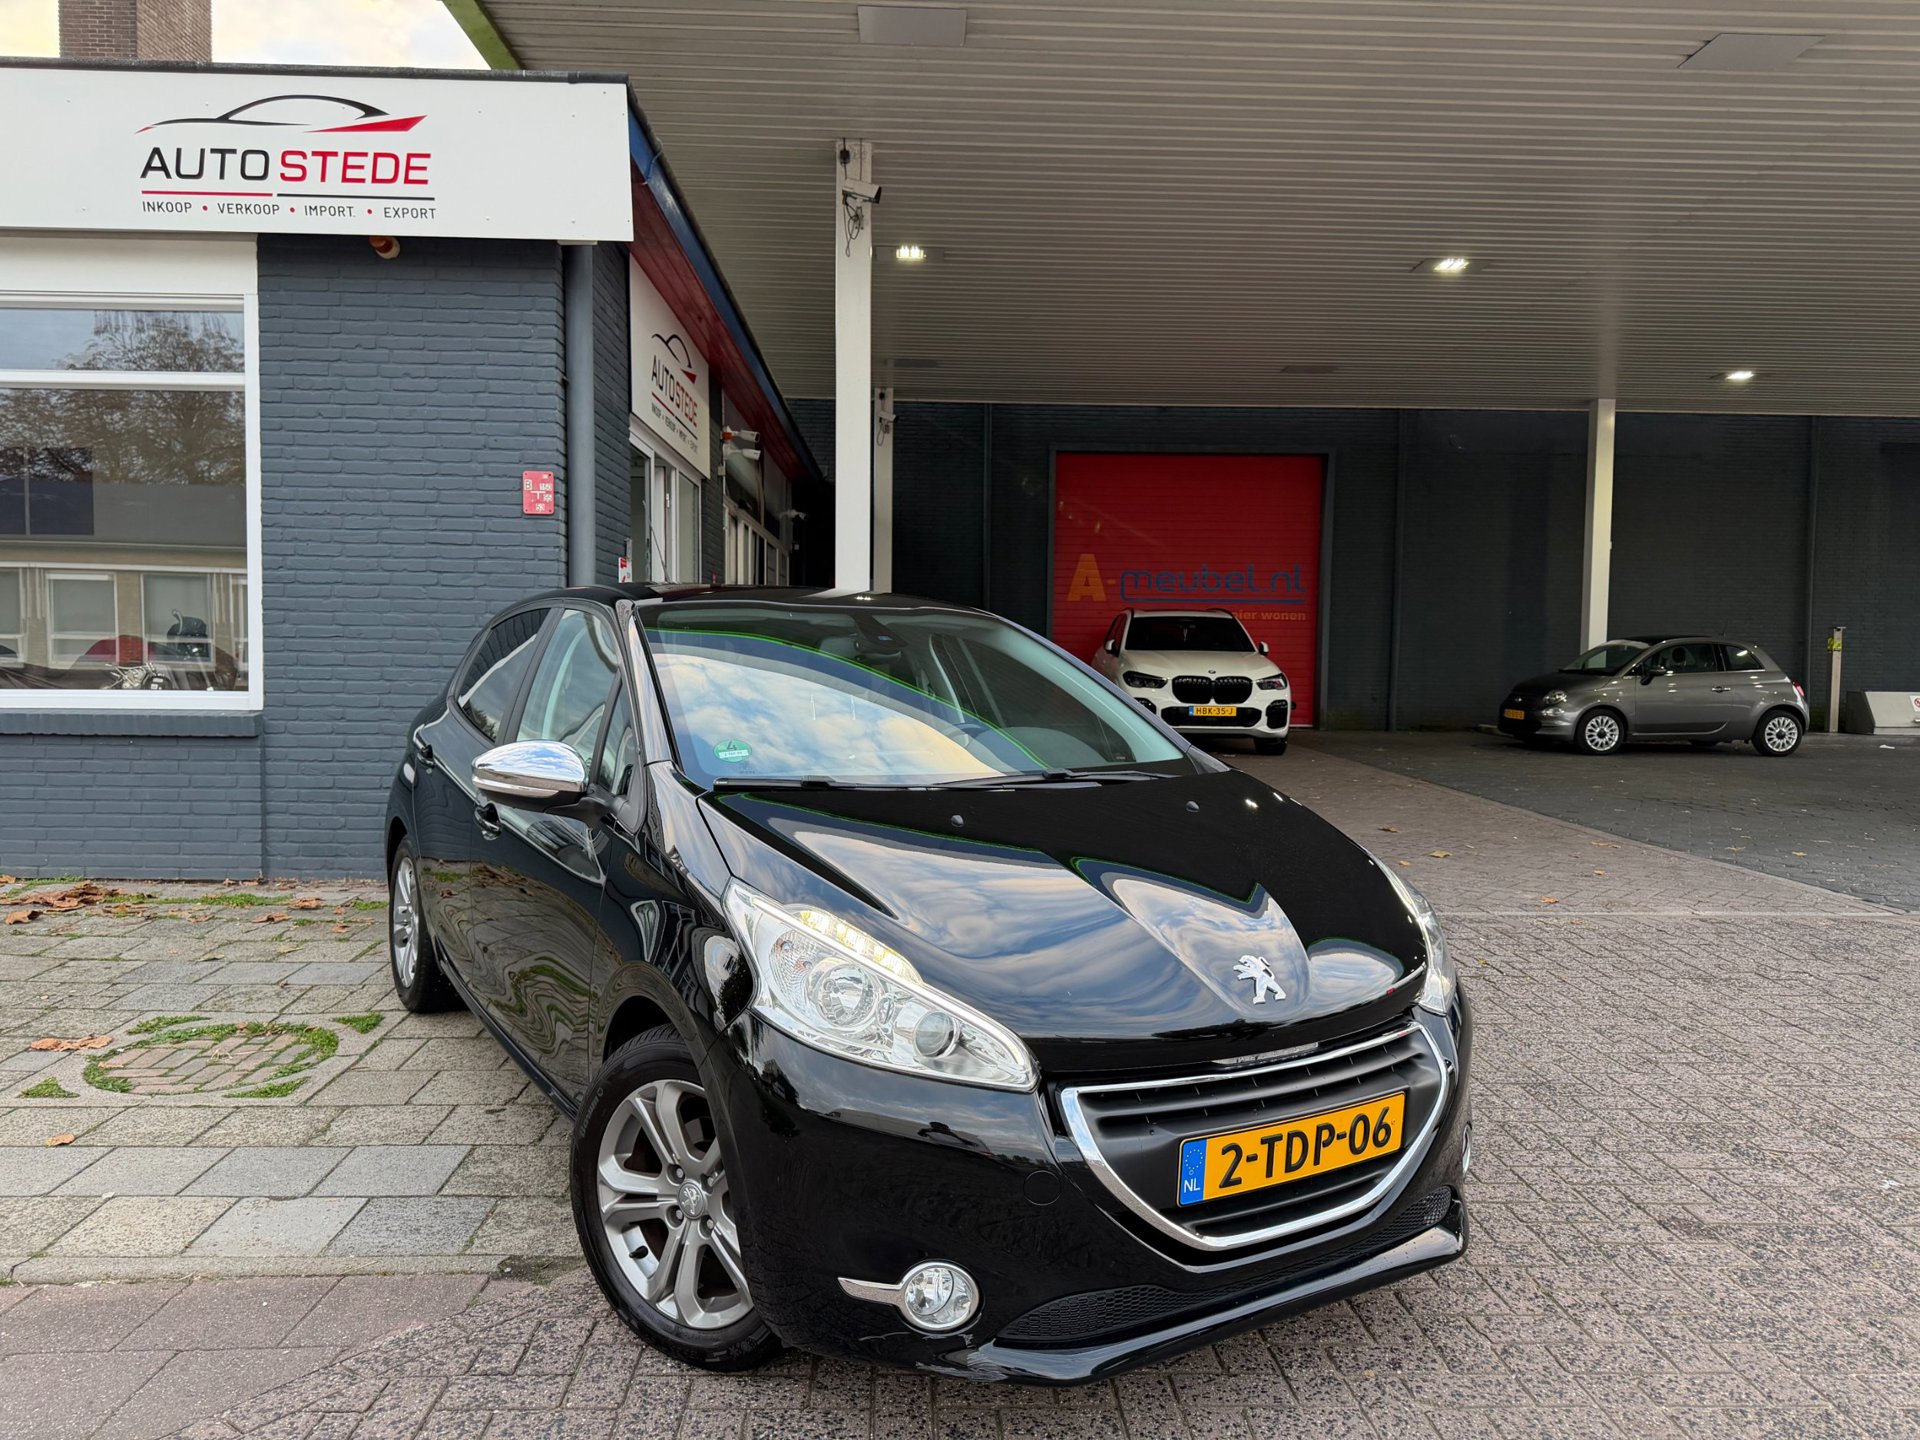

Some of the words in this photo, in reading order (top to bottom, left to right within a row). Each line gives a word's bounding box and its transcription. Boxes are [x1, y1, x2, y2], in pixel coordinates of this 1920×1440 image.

[142, 201, 192, 213] INKOOP
[217, 203, 280, 215] VERKOOP
[304, 205, 354, 217] IMPORT
[383, 207, 437, 219] EXPORT
[1066, 553, 1307, 604] A-meubel.nl
[1260, 612, 1306, 621] wonen
[1196, 707, 1234, 715] HBK-35-J
[1218, 1106, 1392, 1189] 2-TDP-06
[1184, 1179, 1200, 1193] NL
